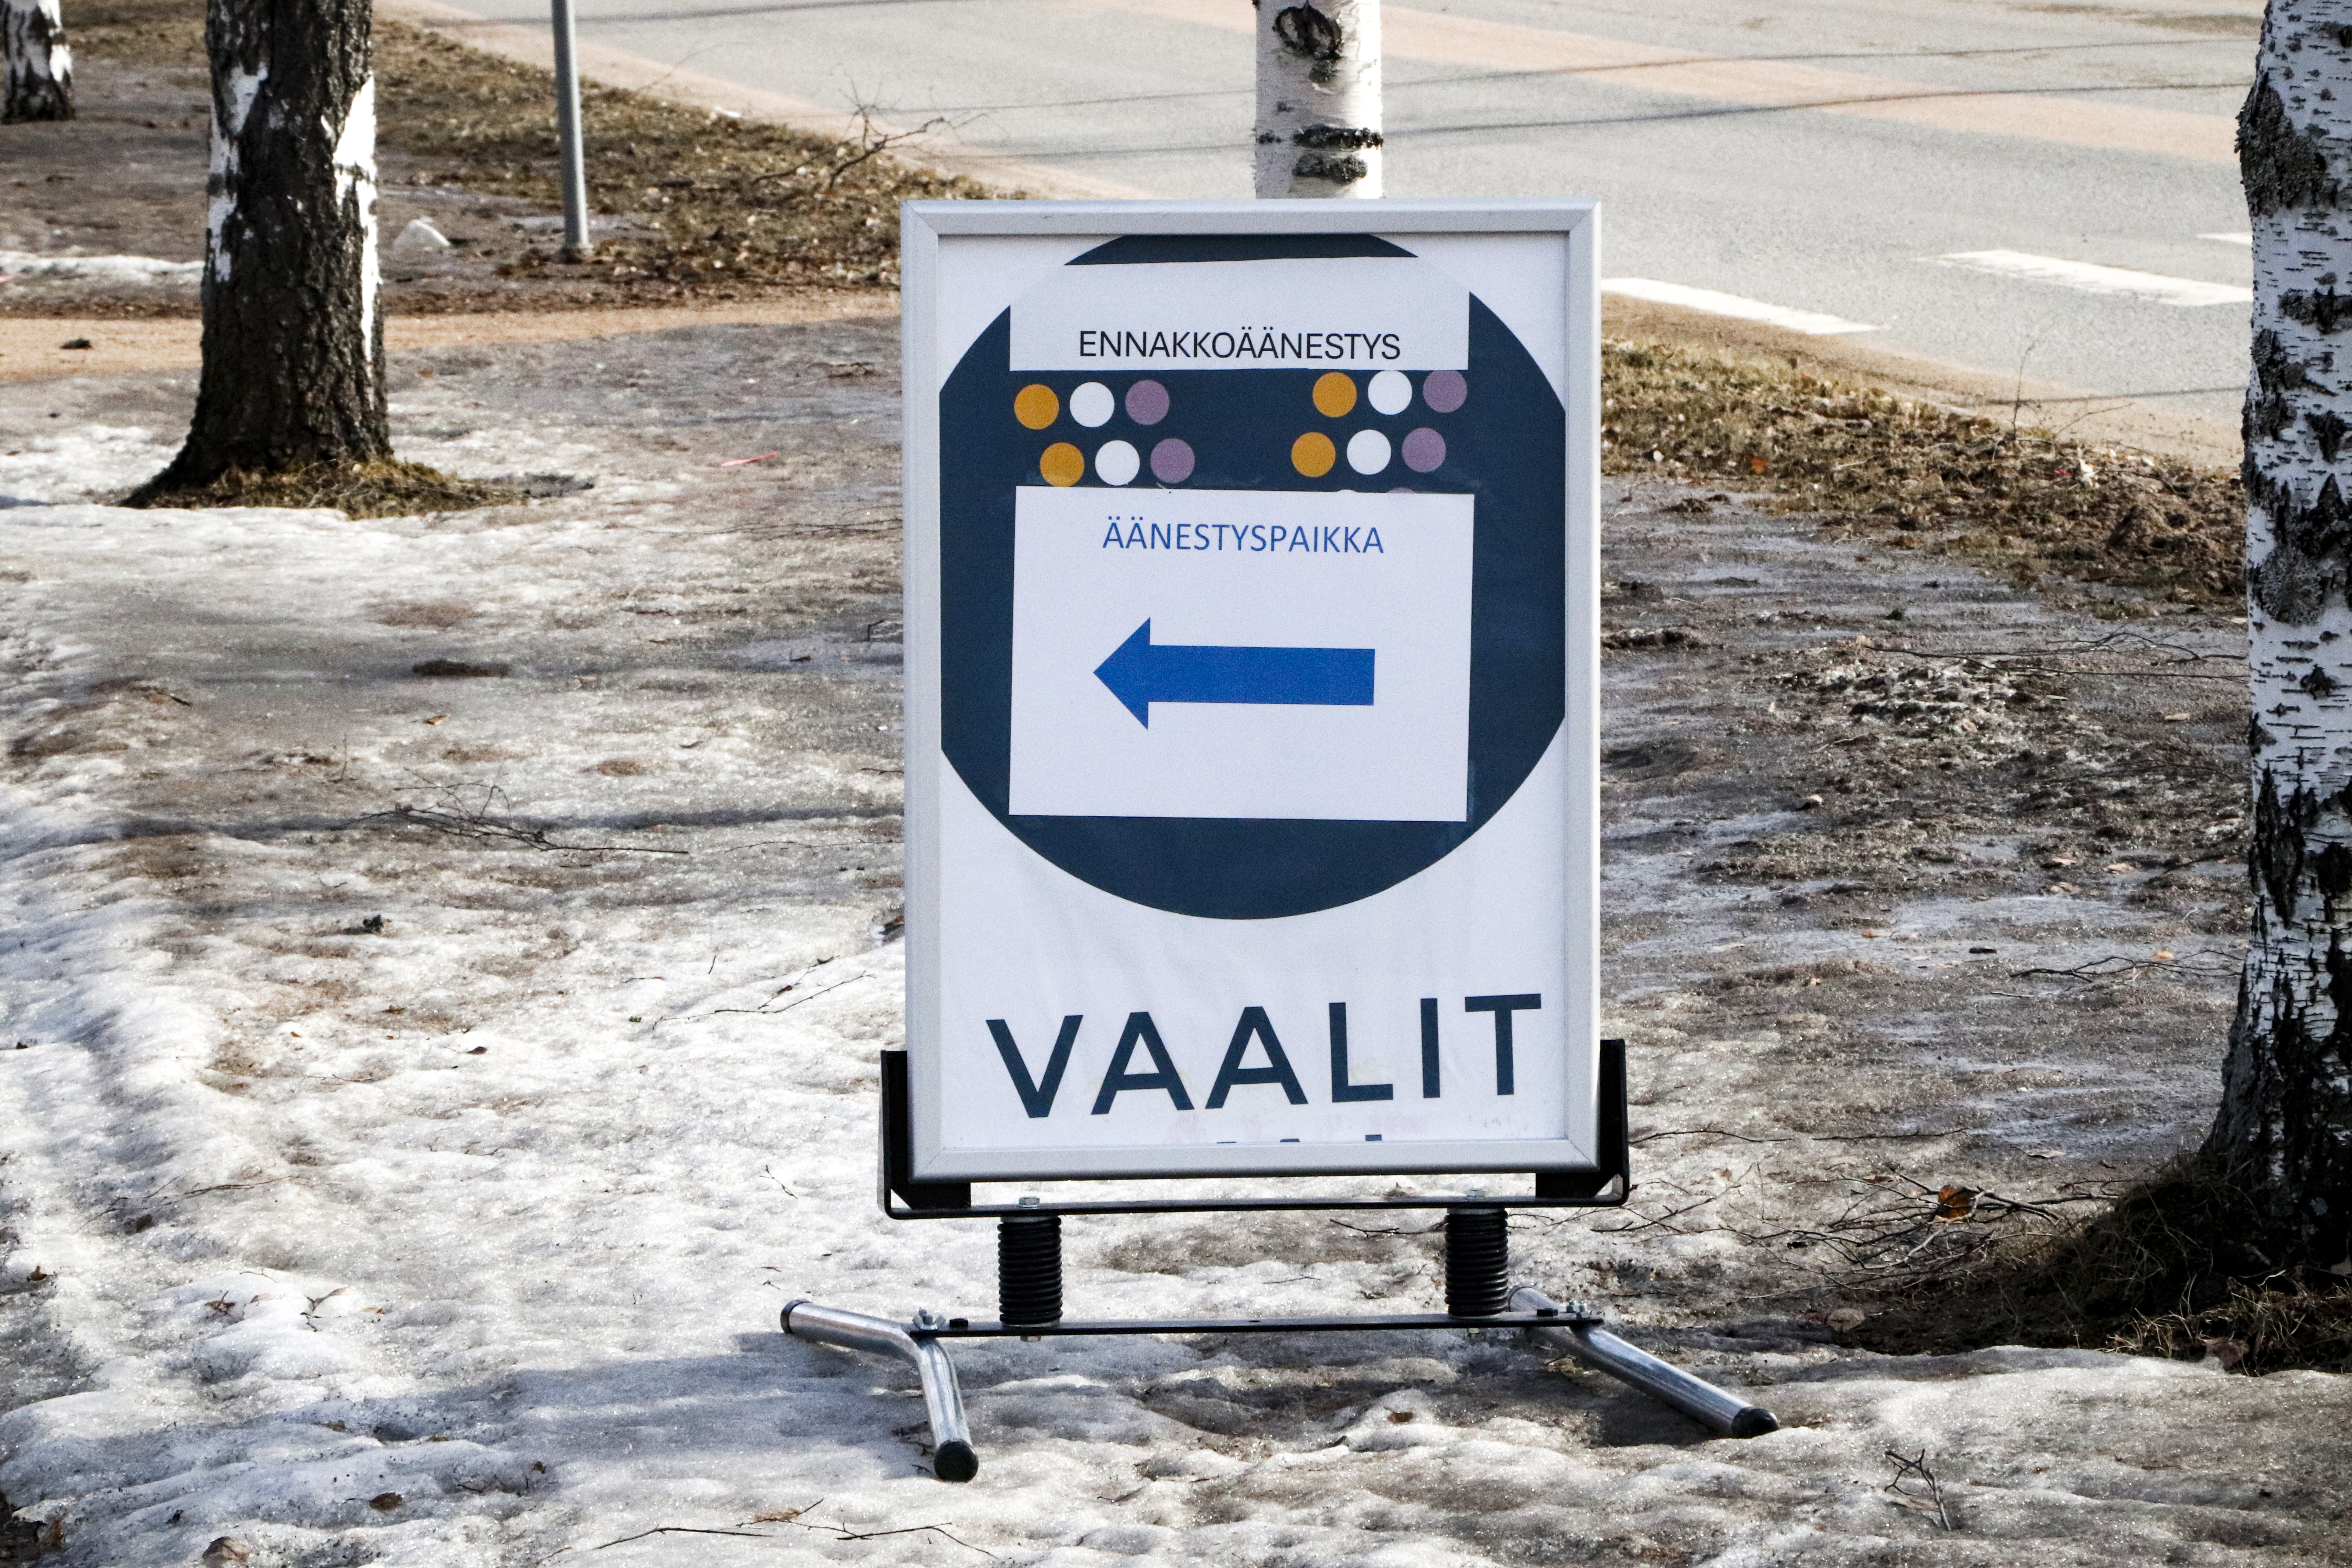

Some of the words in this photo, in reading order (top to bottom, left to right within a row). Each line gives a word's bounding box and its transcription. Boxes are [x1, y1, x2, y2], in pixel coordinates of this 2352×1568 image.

[1080, 326, 1401, 360] ENNAKKOÄÄNESTYS
[1102, 515, 1384, 554] ÄÄNESTYSPAIKKA
[985, 993, 1542, 1119] VAALIT
